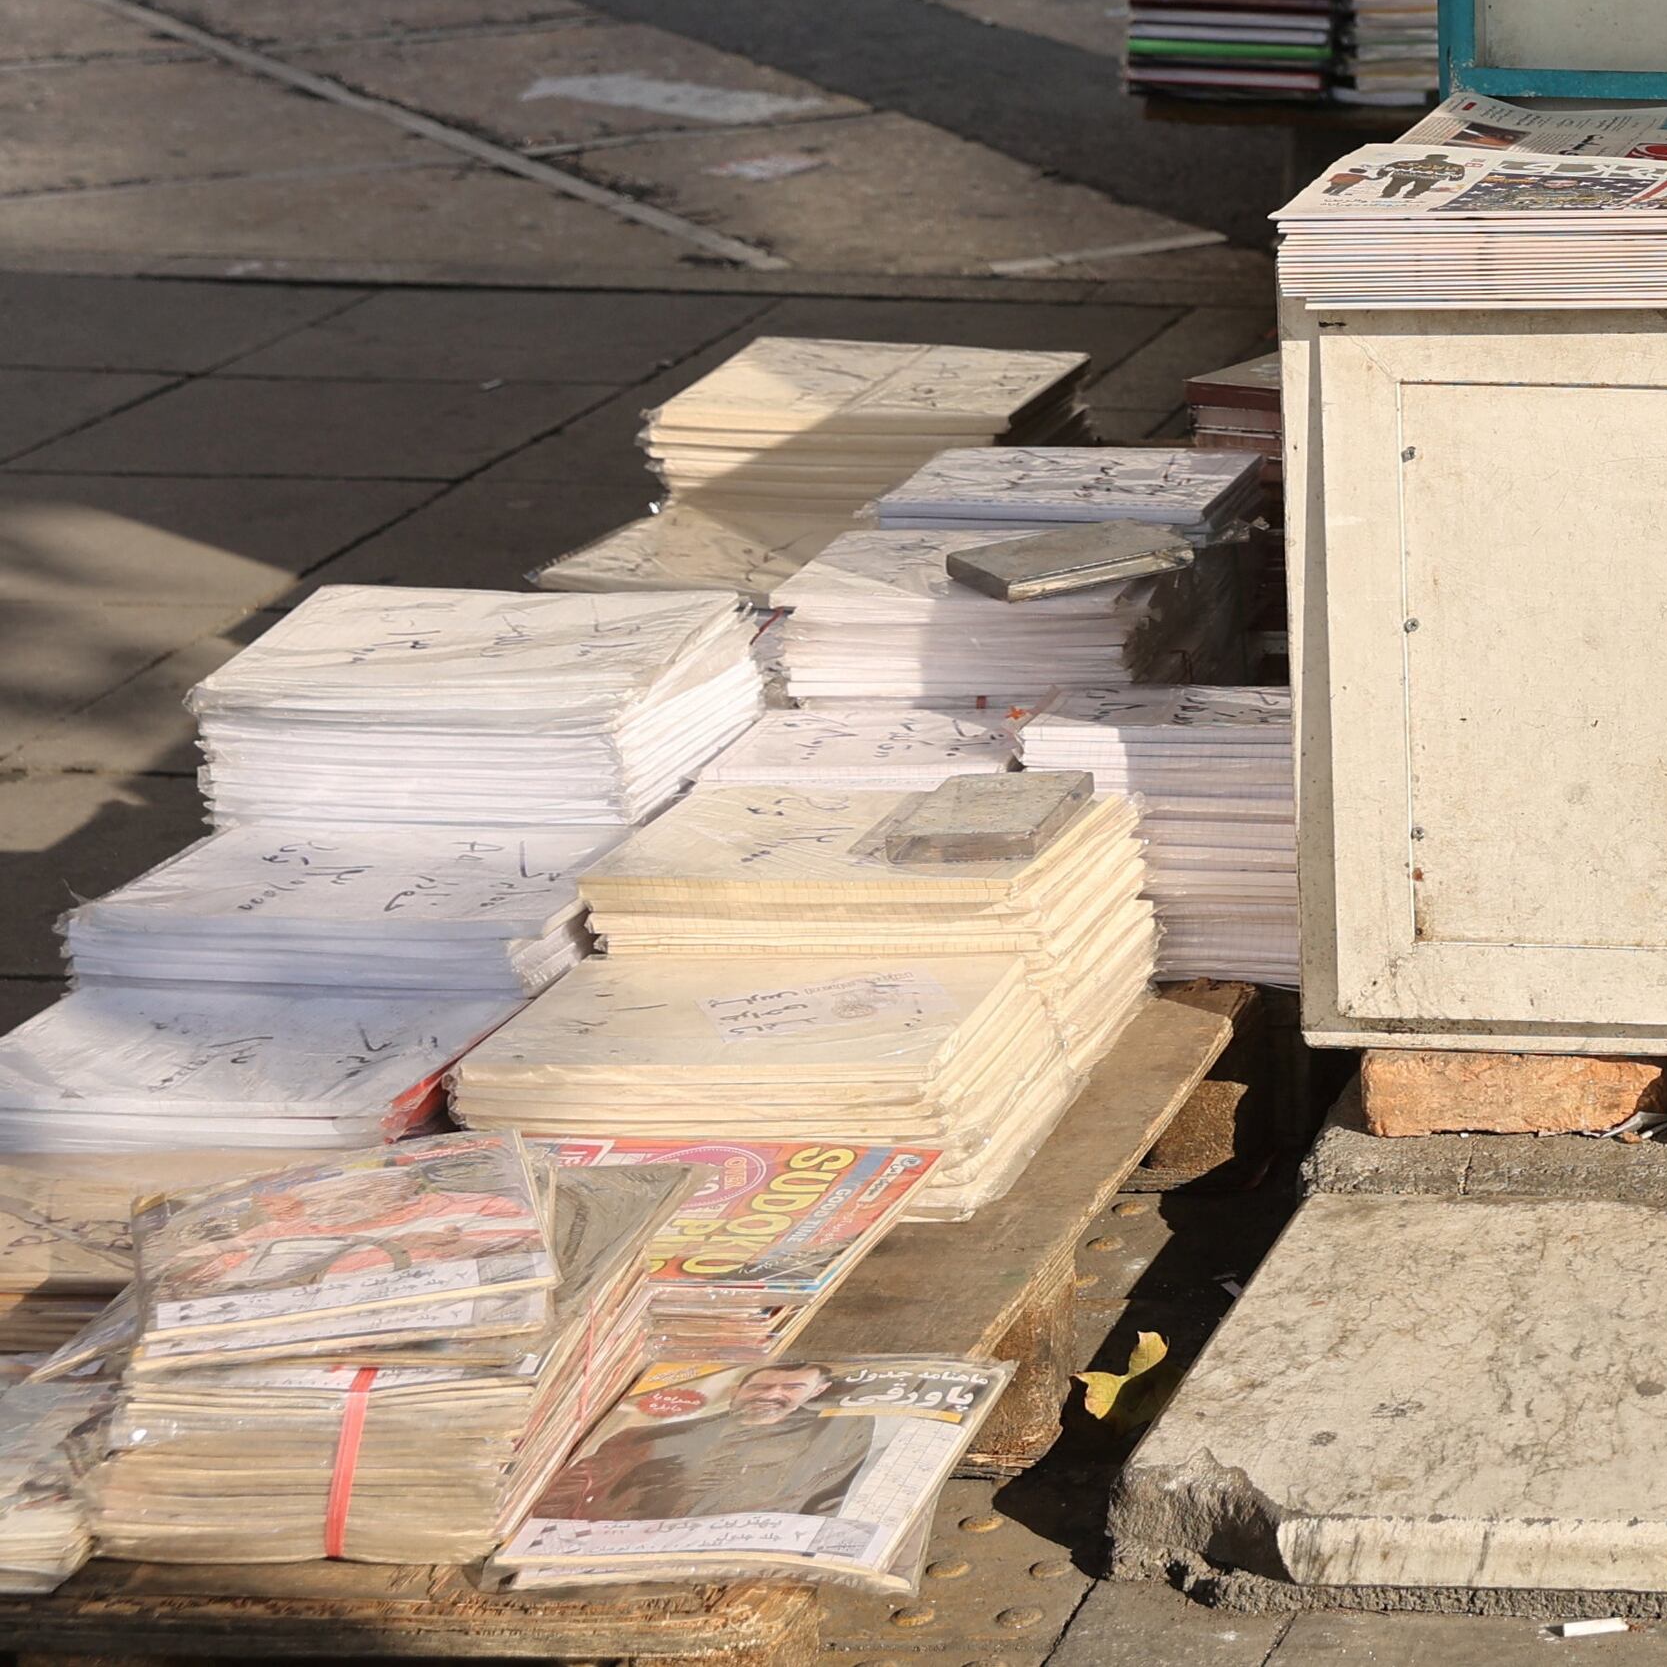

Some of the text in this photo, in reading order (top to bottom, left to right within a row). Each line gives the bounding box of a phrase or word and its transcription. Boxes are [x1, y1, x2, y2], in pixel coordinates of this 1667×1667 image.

[844, 1368, 990, 1386] ماهنامه جدول
[839, 1382, 975, 1411] پاورقی
